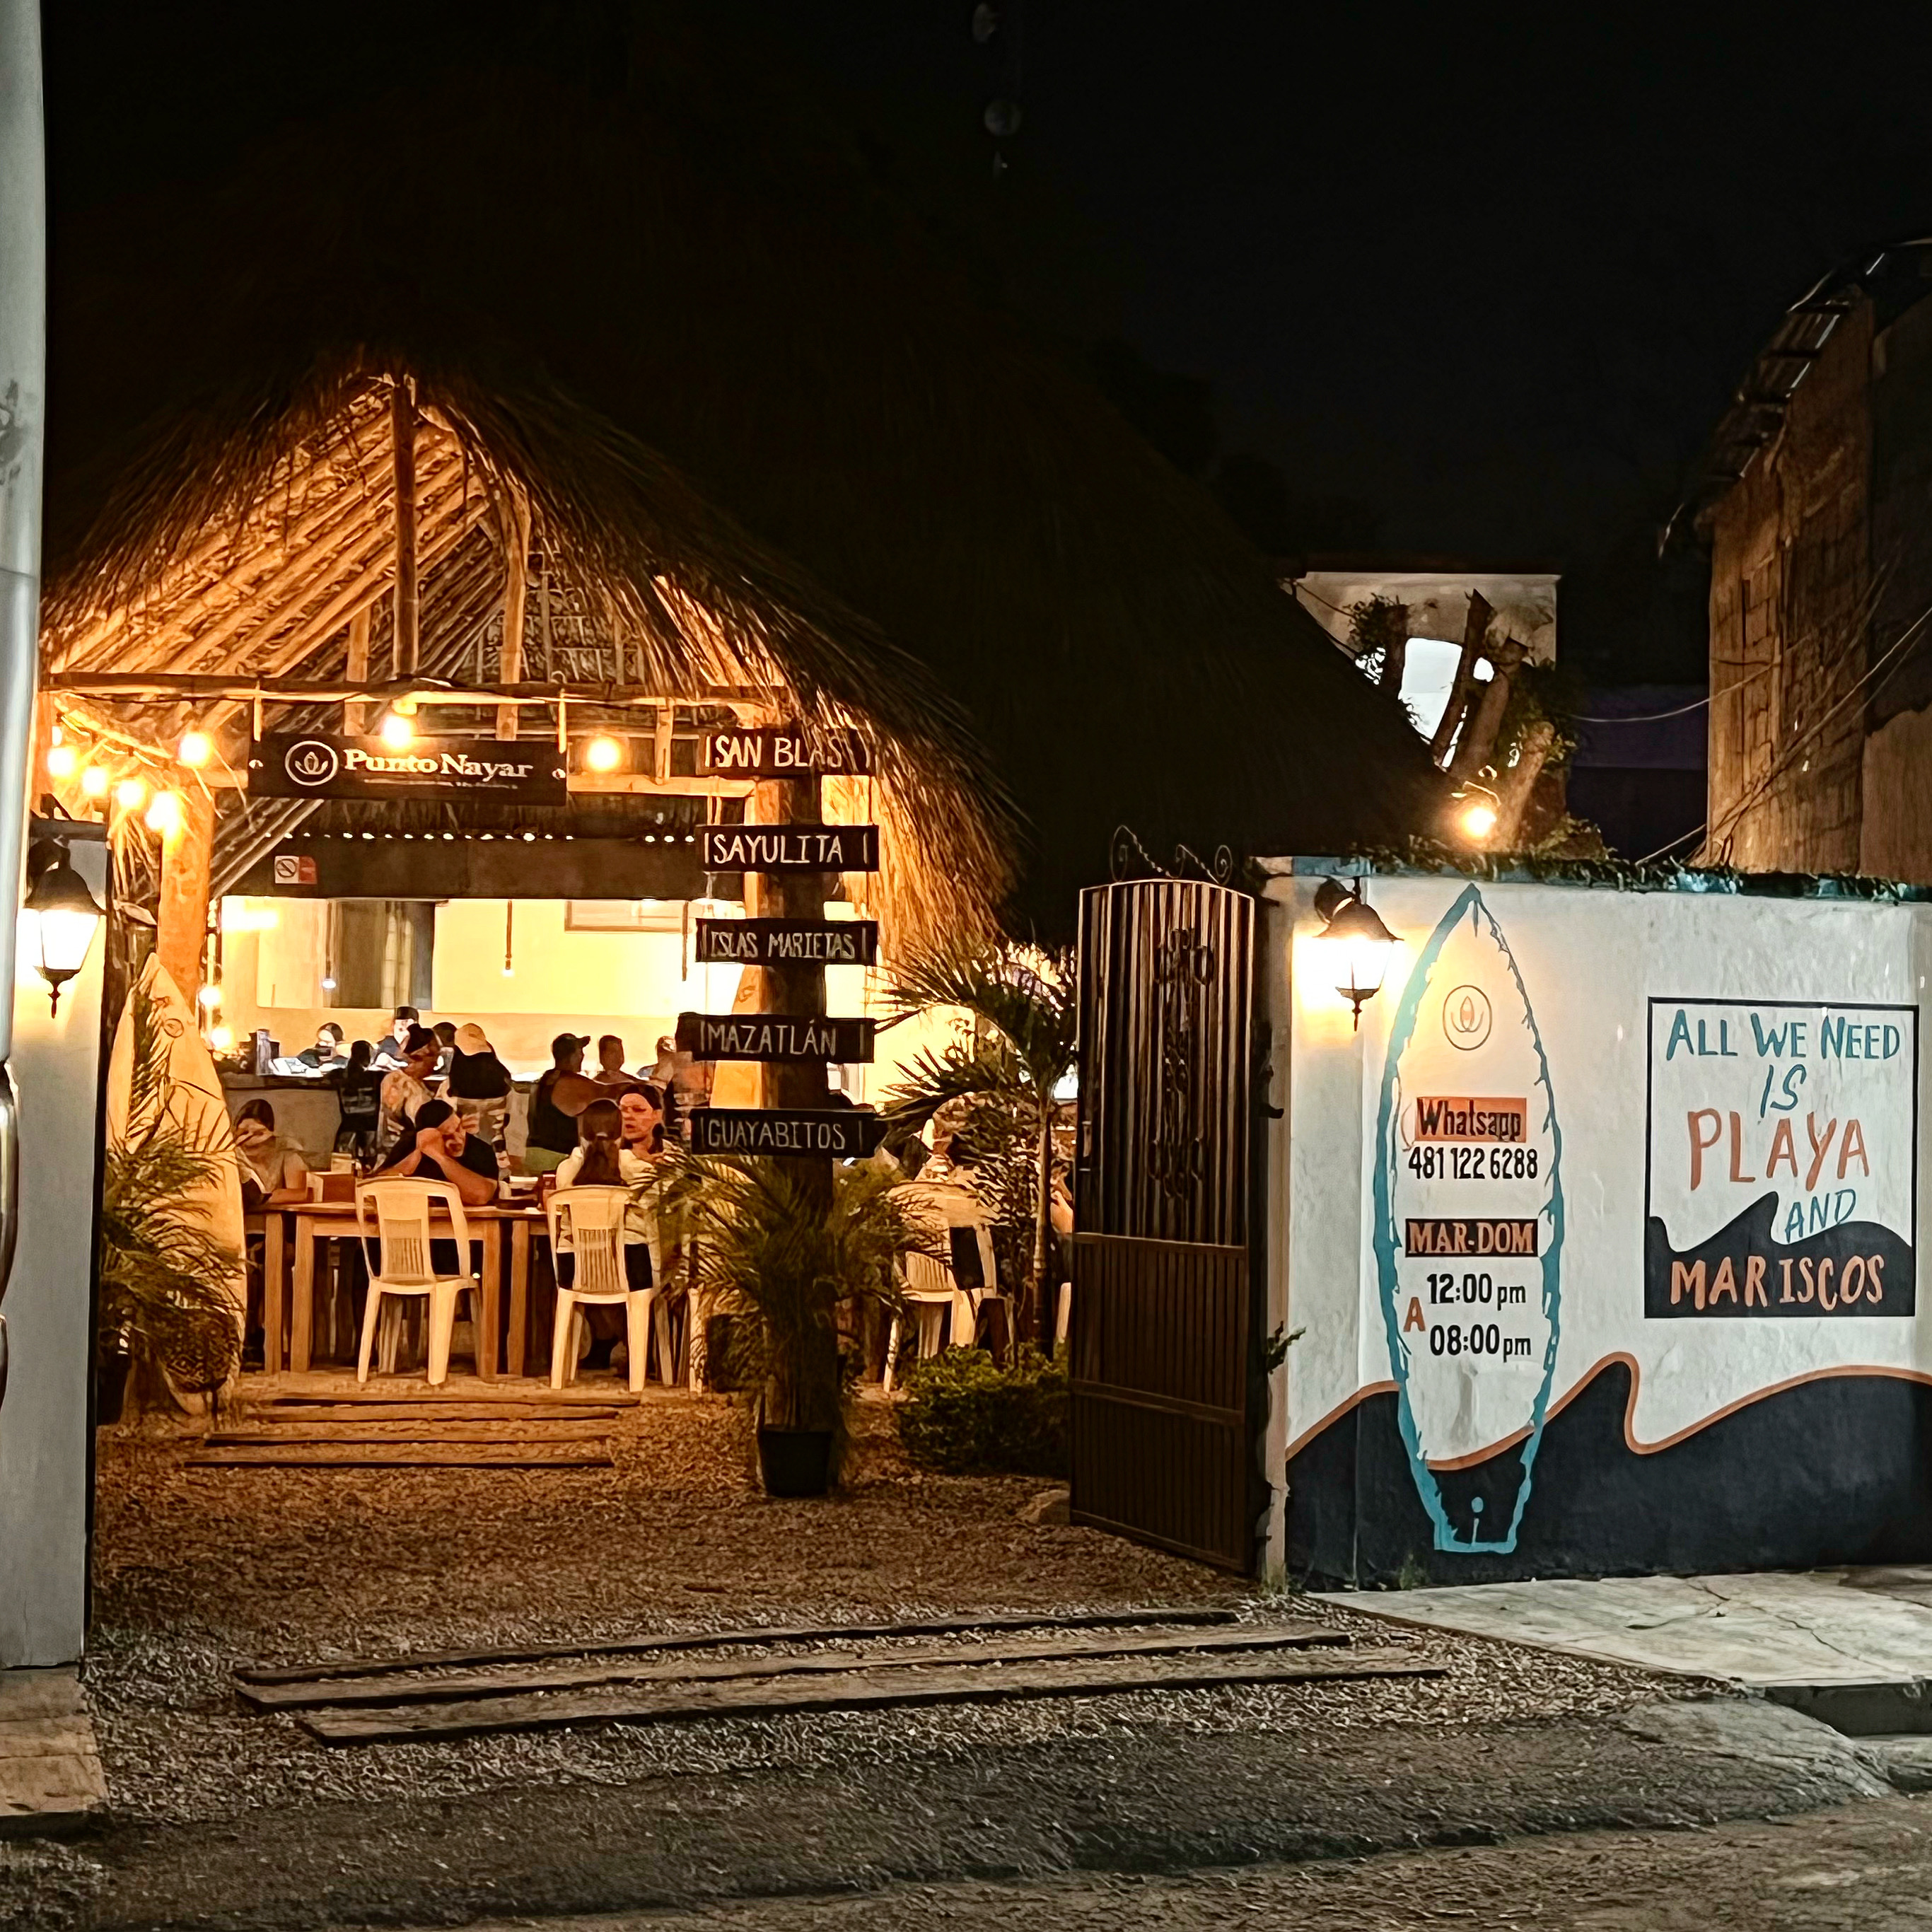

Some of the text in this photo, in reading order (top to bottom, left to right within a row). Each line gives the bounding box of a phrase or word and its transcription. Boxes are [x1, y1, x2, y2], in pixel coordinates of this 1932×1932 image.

[715, 735, 762, 767] SAN
[714, 834, 843, 863] SAYULITA
[711, 931, 855, 960] ISLAS MARIETAS
[709, 1019, 836, 1056] MAZATLÁN
[1666, 1009, 1900, 1061] ALL WE NEED
[1760, 1064, 1807, 1118] IS
[709, 1119, 845, 1150] GUAYABITOS
[1418, 1099, 1521, 1142] Whatsapp
[1409, 1146, 1537, 1179] 481 122 6288
[1687, 1108, 1869, 1192] PLAYA
[1784, 1189, 1856, 1243] AND
[1408, 1222, 1534, 1254] MAR-DOM
[1427, 1274, 1526, 1311] 12:00 pm
[1403, 1296, 1426, 1332] A
[1430, 1324, 1532, 1363] 08:00 pm
